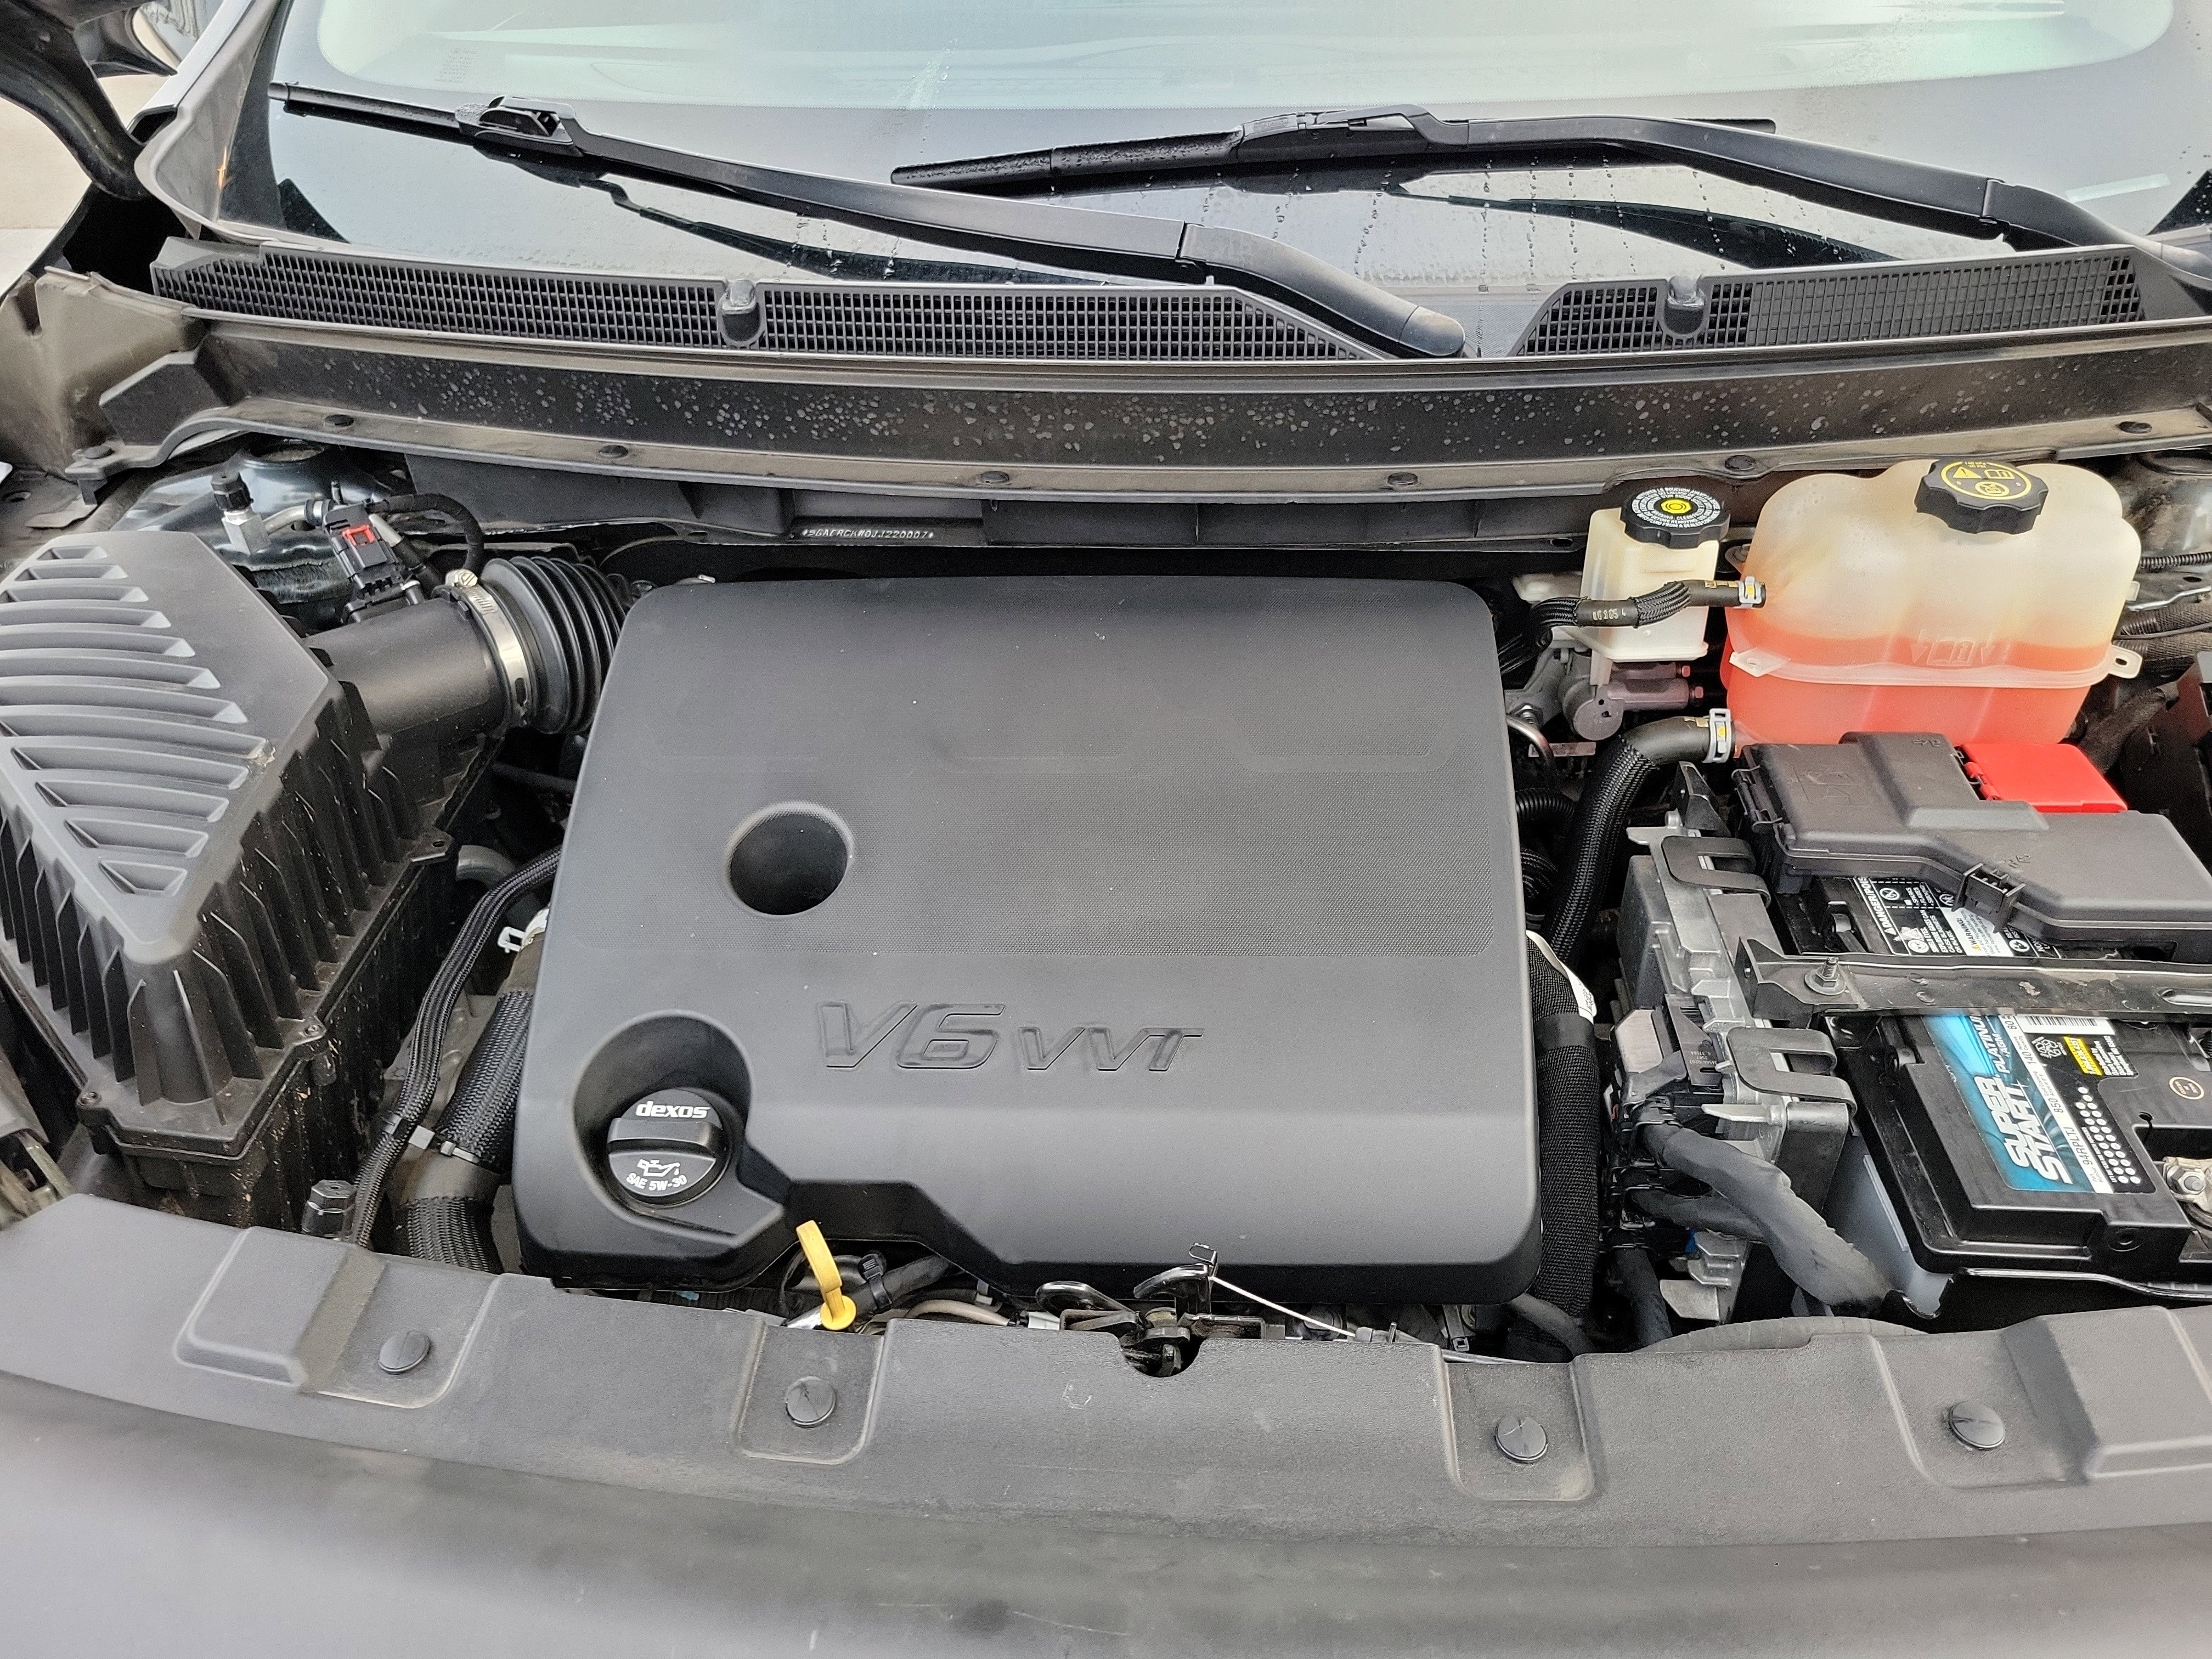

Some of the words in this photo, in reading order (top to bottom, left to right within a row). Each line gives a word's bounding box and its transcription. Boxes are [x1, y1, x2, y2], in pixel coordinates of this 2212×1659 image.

[1955, 917, 1978, 945] WARNING:
[816, 1000, 1006, 1070] V6
[1018, 1024, 1204, 1072] VVT
[2004, 1020, 2017, 1029] 80
[2021, 1051, 2037, 1064] 140
[636, 1101, 710, 1119] dexos
[2047, 1098, 2064, 1113] 850
[1974, 1076, 2030, 1167] SUPER
[1993, 1075, 2073, 1184] START
[2063, 1127, 2094, 1165] 94RPLTJ
[626, 1172, 648, 1189] SAE
[648, 1174, 688, 1191] 5W-30
